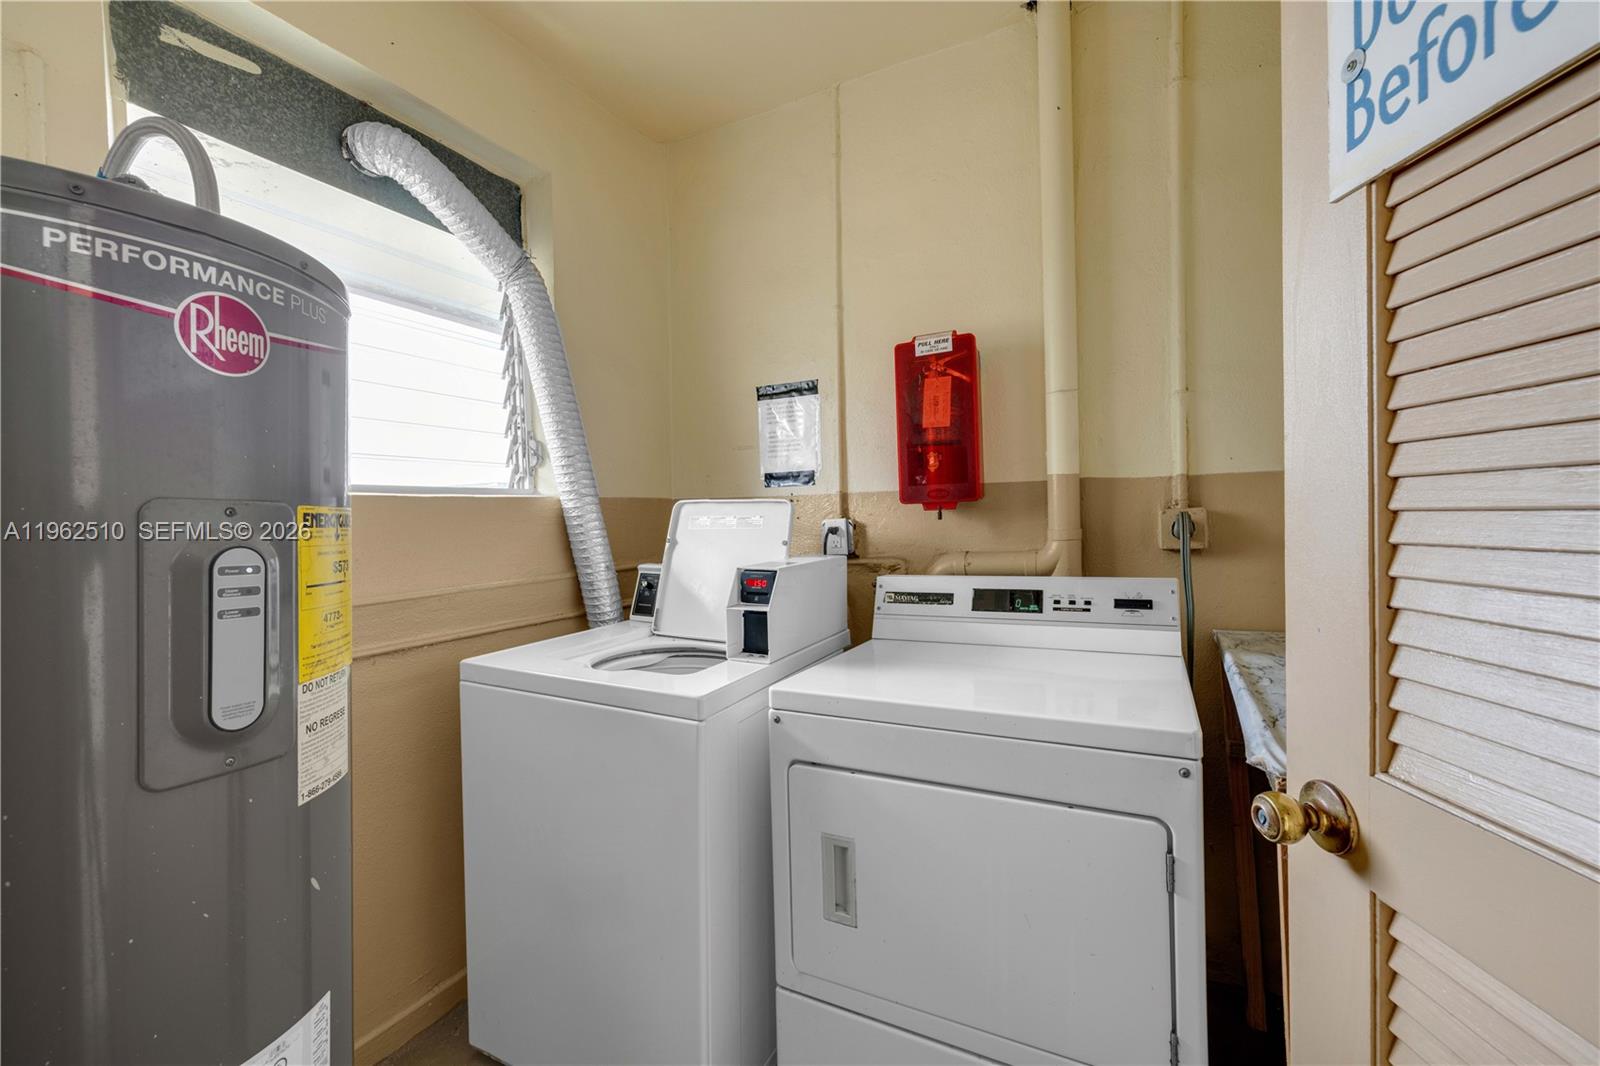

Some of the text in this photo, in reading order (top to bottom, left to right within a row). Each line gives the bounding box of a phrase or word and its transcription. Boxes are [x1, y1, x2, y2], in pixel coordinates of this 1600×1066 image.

[42, 227, 326, 325] PERFORMANCE PLUS
[190, 295, 265, 362] Rheem
[302, 682, 314, 694] DO
[315, 676, 328, 690] NOT
[305, 721, 318, 735] NO
